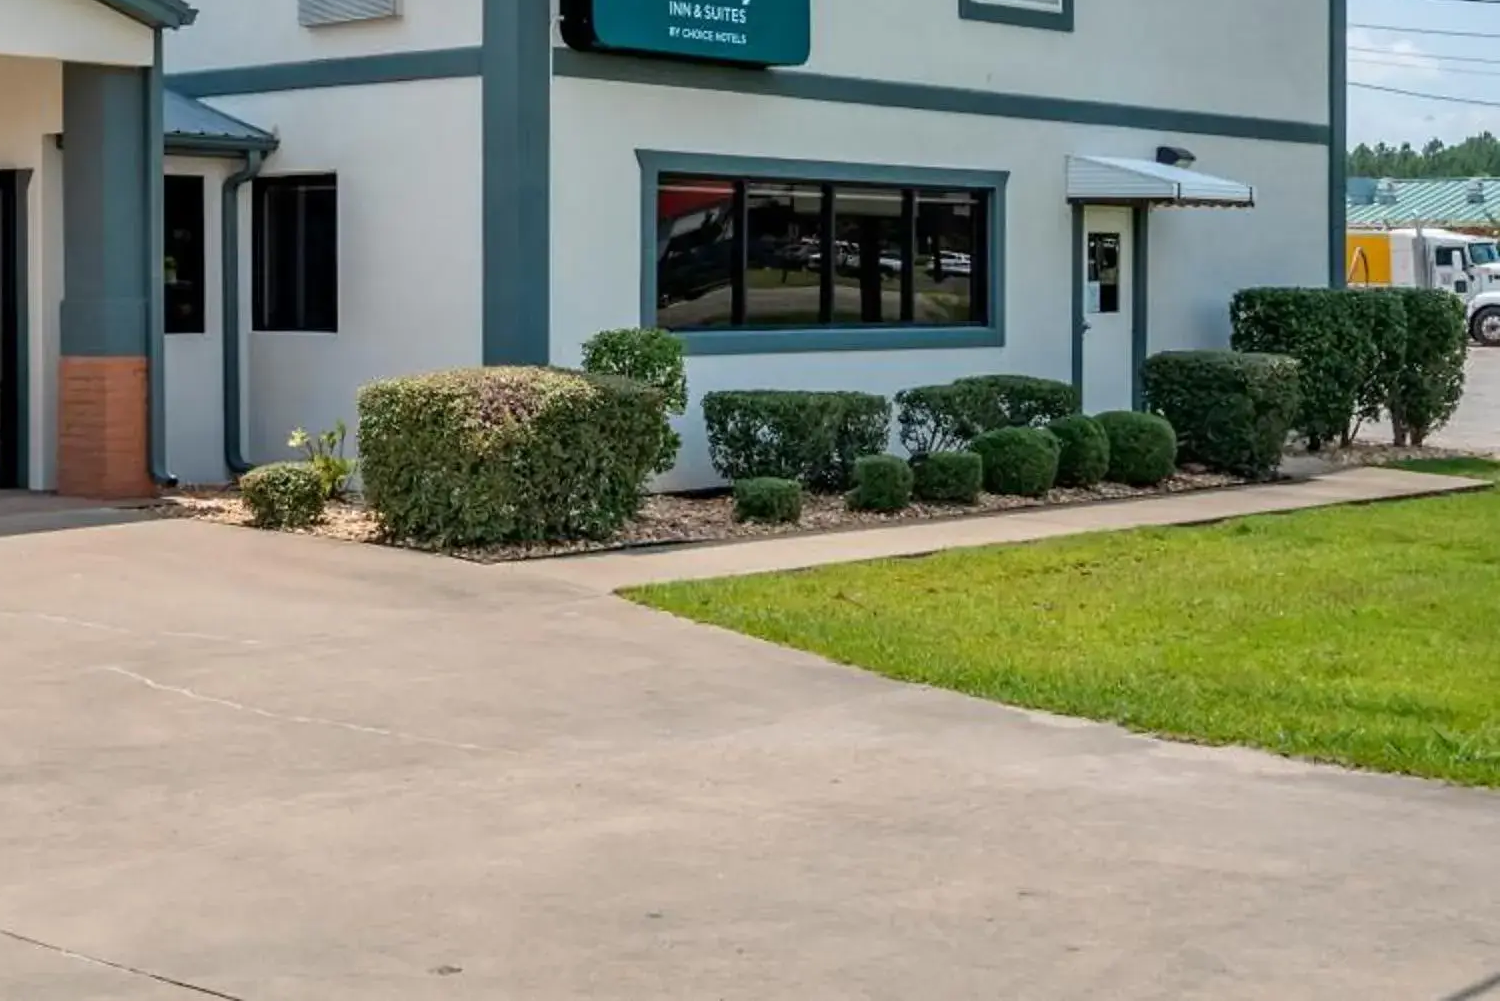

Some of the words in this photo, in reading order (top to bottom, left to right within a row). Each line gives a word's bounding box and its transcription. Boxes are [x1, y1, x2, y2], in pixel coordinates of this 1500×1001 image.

[669, 1, 691, 17] INN
[693, 4, 702, 18] &
[703, 4, 747, 24] SUITES
[669, 26, 680, 38] BY
[682, 28, 713, 42] CHOICE
[715, 31, 747, 44] HOTELS
